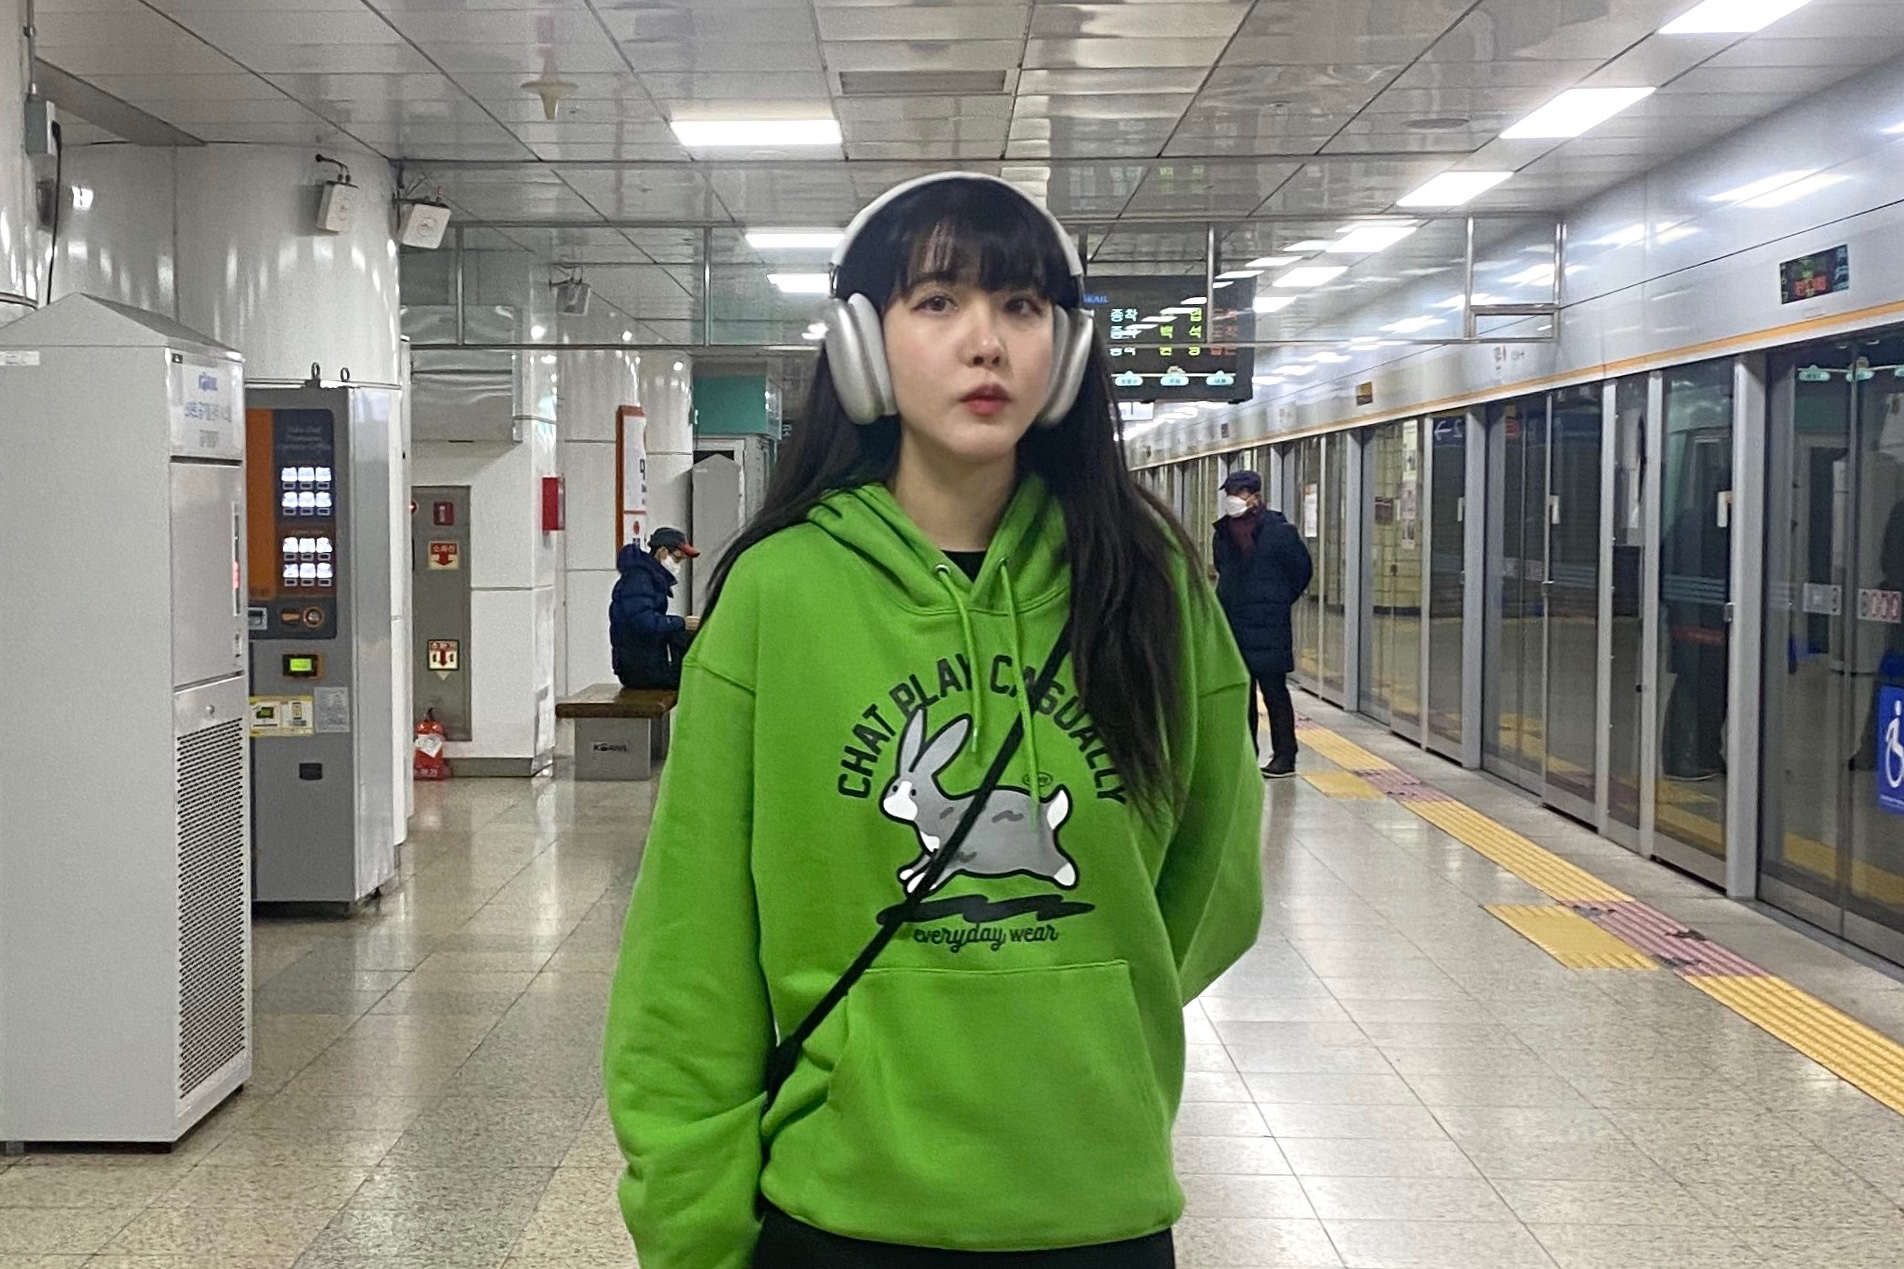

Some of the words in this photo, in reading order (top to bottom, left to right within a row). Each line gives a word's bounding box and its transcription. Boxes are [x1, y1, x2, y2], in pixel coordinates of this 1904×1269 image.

[837, 703, 897, 799] CHAT
[913, 922, 1006, 954] everyday
[1009, 923, 1059, 943] wear
